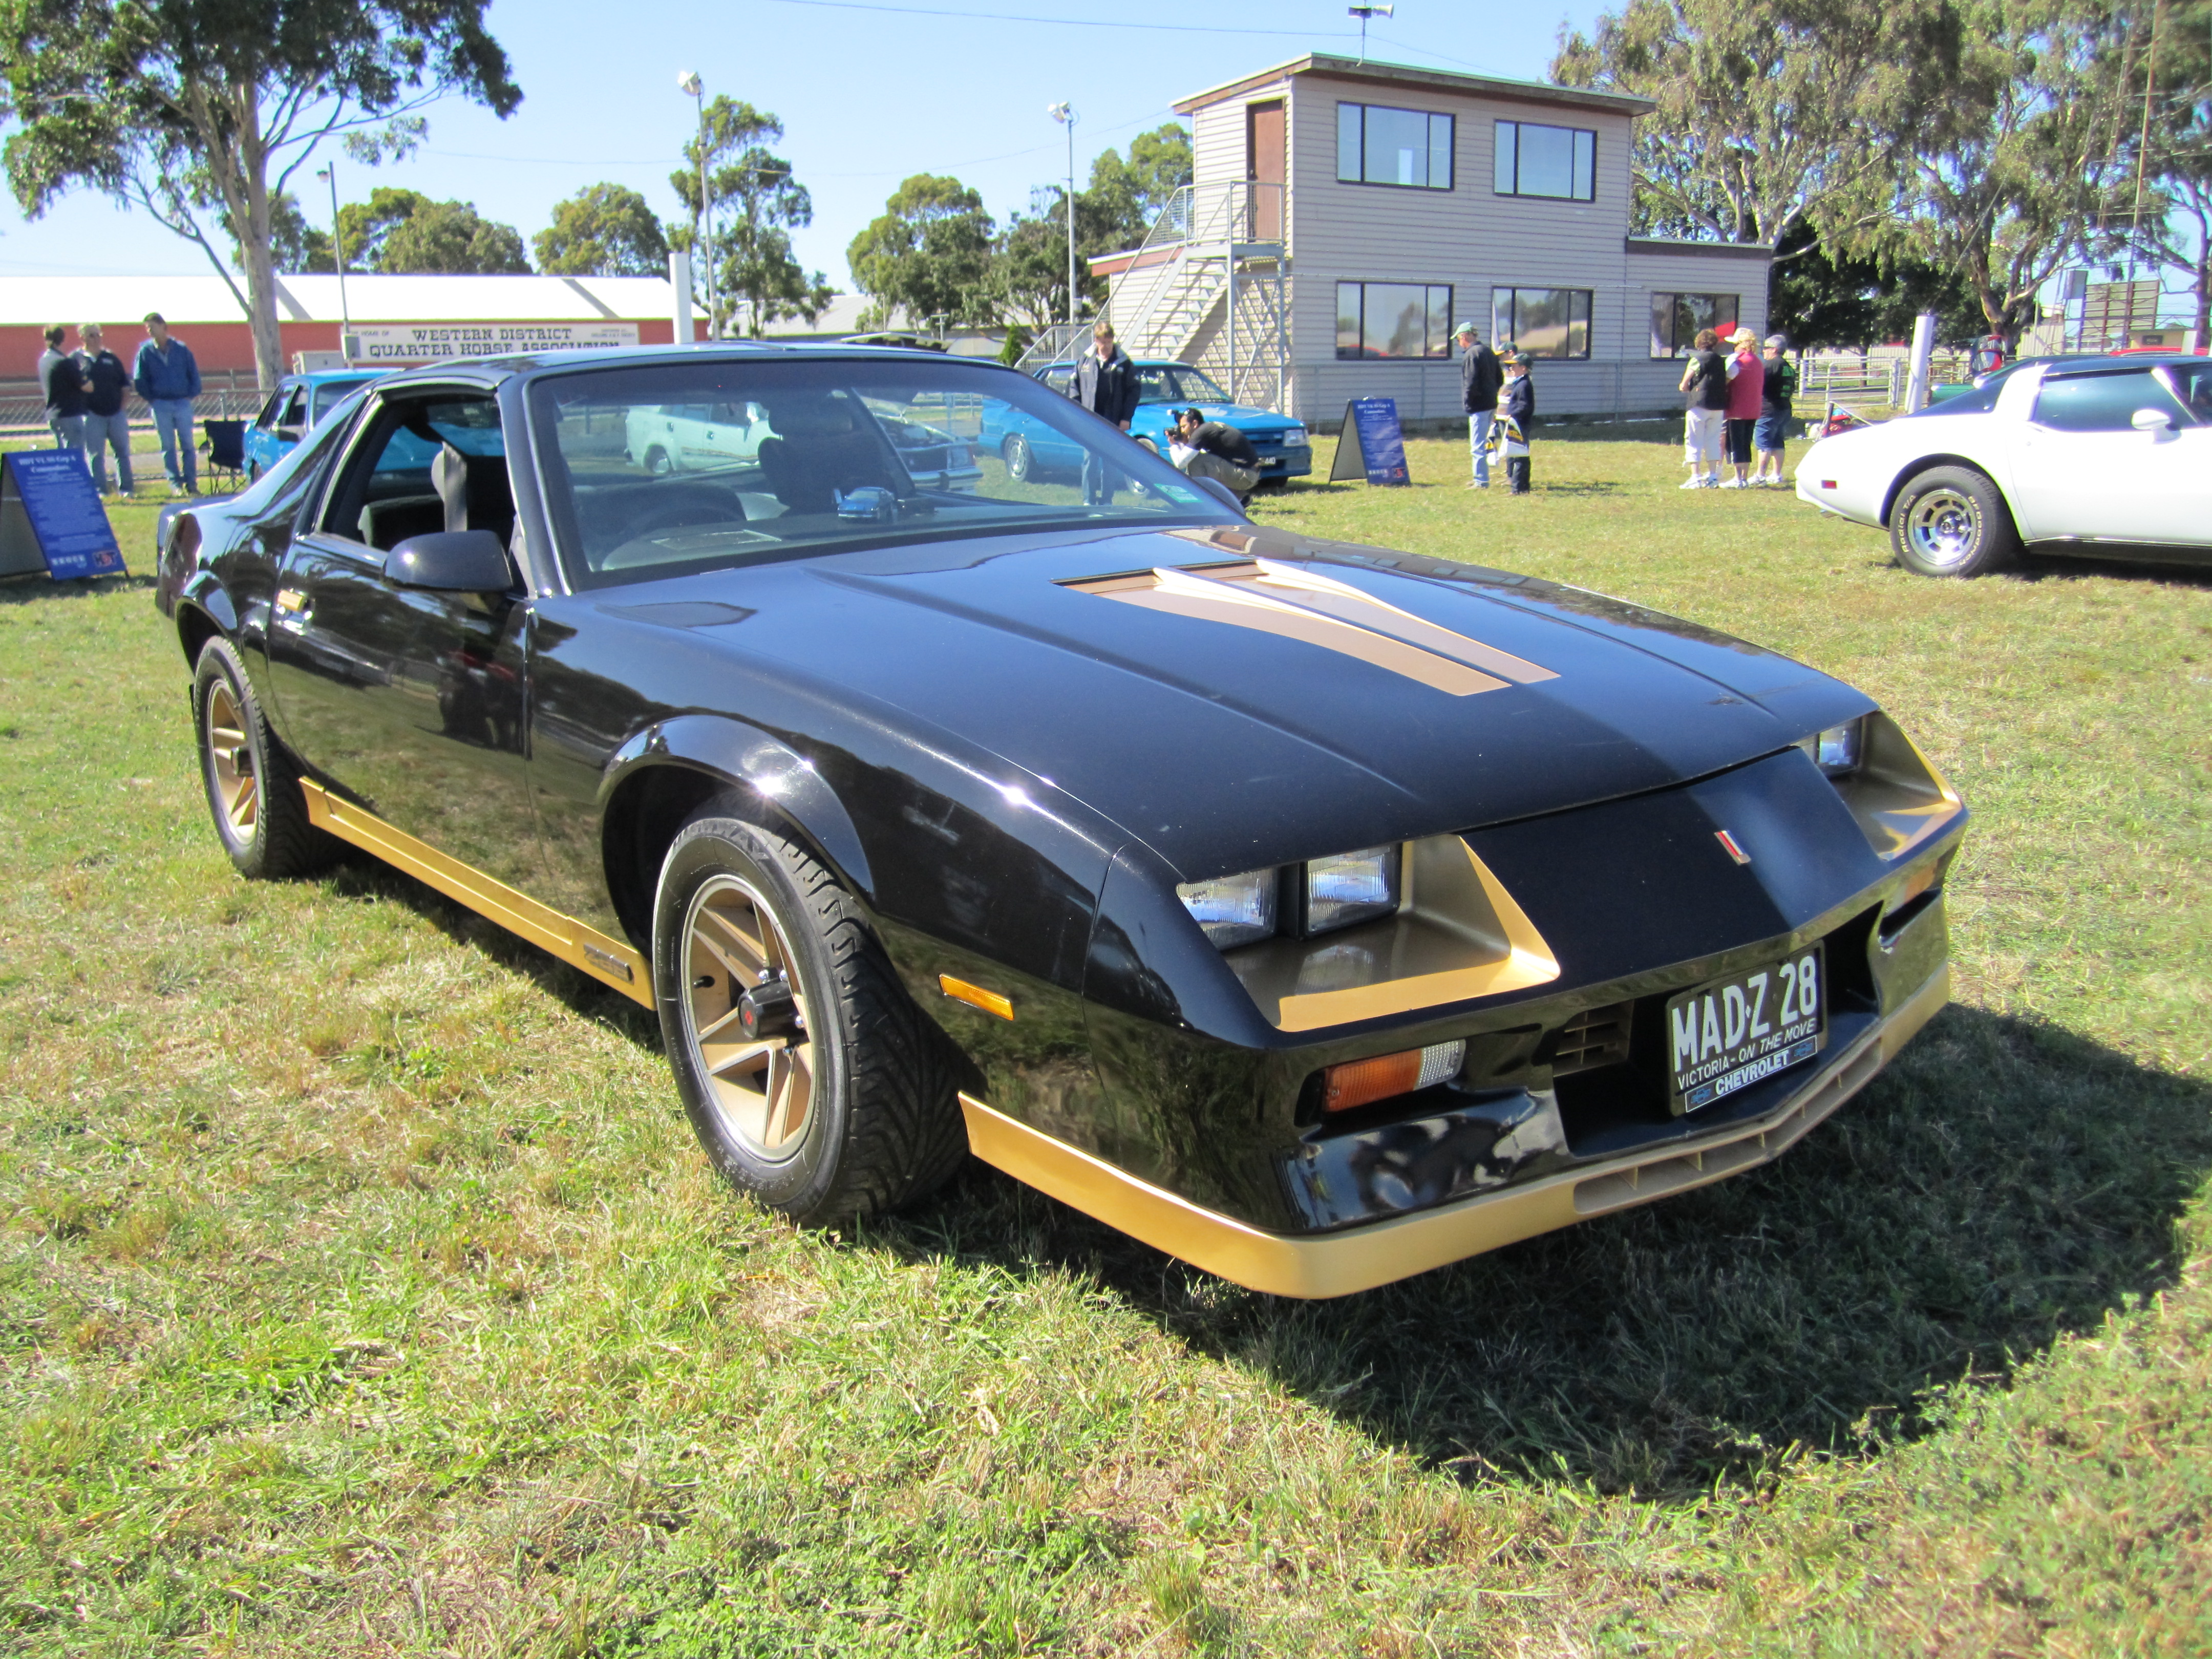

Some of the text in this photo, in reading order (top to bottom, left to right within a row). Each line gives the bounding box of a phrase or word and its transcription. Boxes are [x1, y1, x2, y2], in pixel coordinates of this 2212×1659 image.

[369, 344, 453, 357] QUARTER
[459, 342, 513, 355] HORSE
[411, 328, 571, 342] WESTERN DISTRICT
[1779, 955, 1817, 1026] 28
[1677, 1057, 1730, 1090] VICTORIA
[1738, 1045, 1755, 1063] ON
[1760, 1034, 1782, 1054] THE
[1784, 1017, 1816, 1041] MOVE
[1715, 1049, 1791, 1096] CHEVROLET
